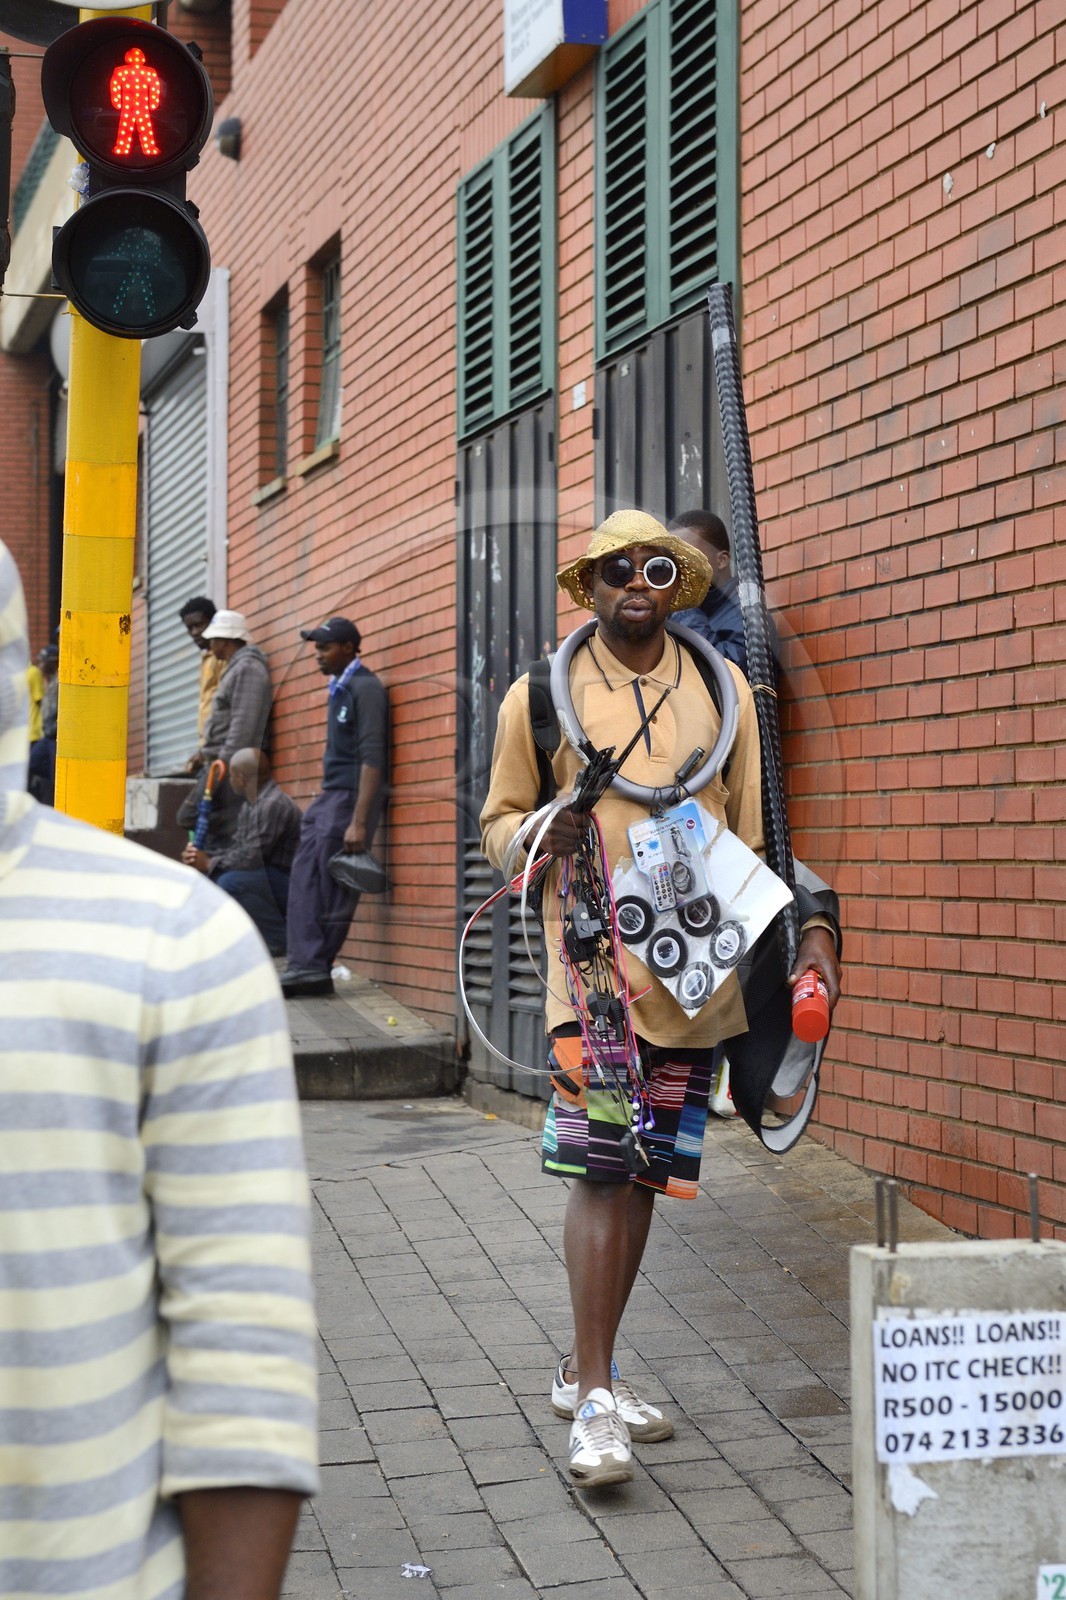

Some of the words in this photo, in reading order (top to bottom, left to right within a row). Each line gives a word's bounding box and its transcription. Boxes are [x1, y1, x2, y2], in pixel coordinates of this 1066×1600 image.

[880, 1325, 965, 1348] LOANS!!
[976, 1320, 1061, 1344] LOANS!!
[882, 1363, 917, 1383] NO
[925, 1360, 960, 1381] ITC
[968, 1355, 1062, 1378] CHECK!!
[884, 1396, 953, 1418] R500
[980, 1390, 1063, 1413] 15000
[885, 1432, 933, 1453] 074
[942, 1428, 990, 1450] 213
[999, 1423, 1064, 1447] 2336
